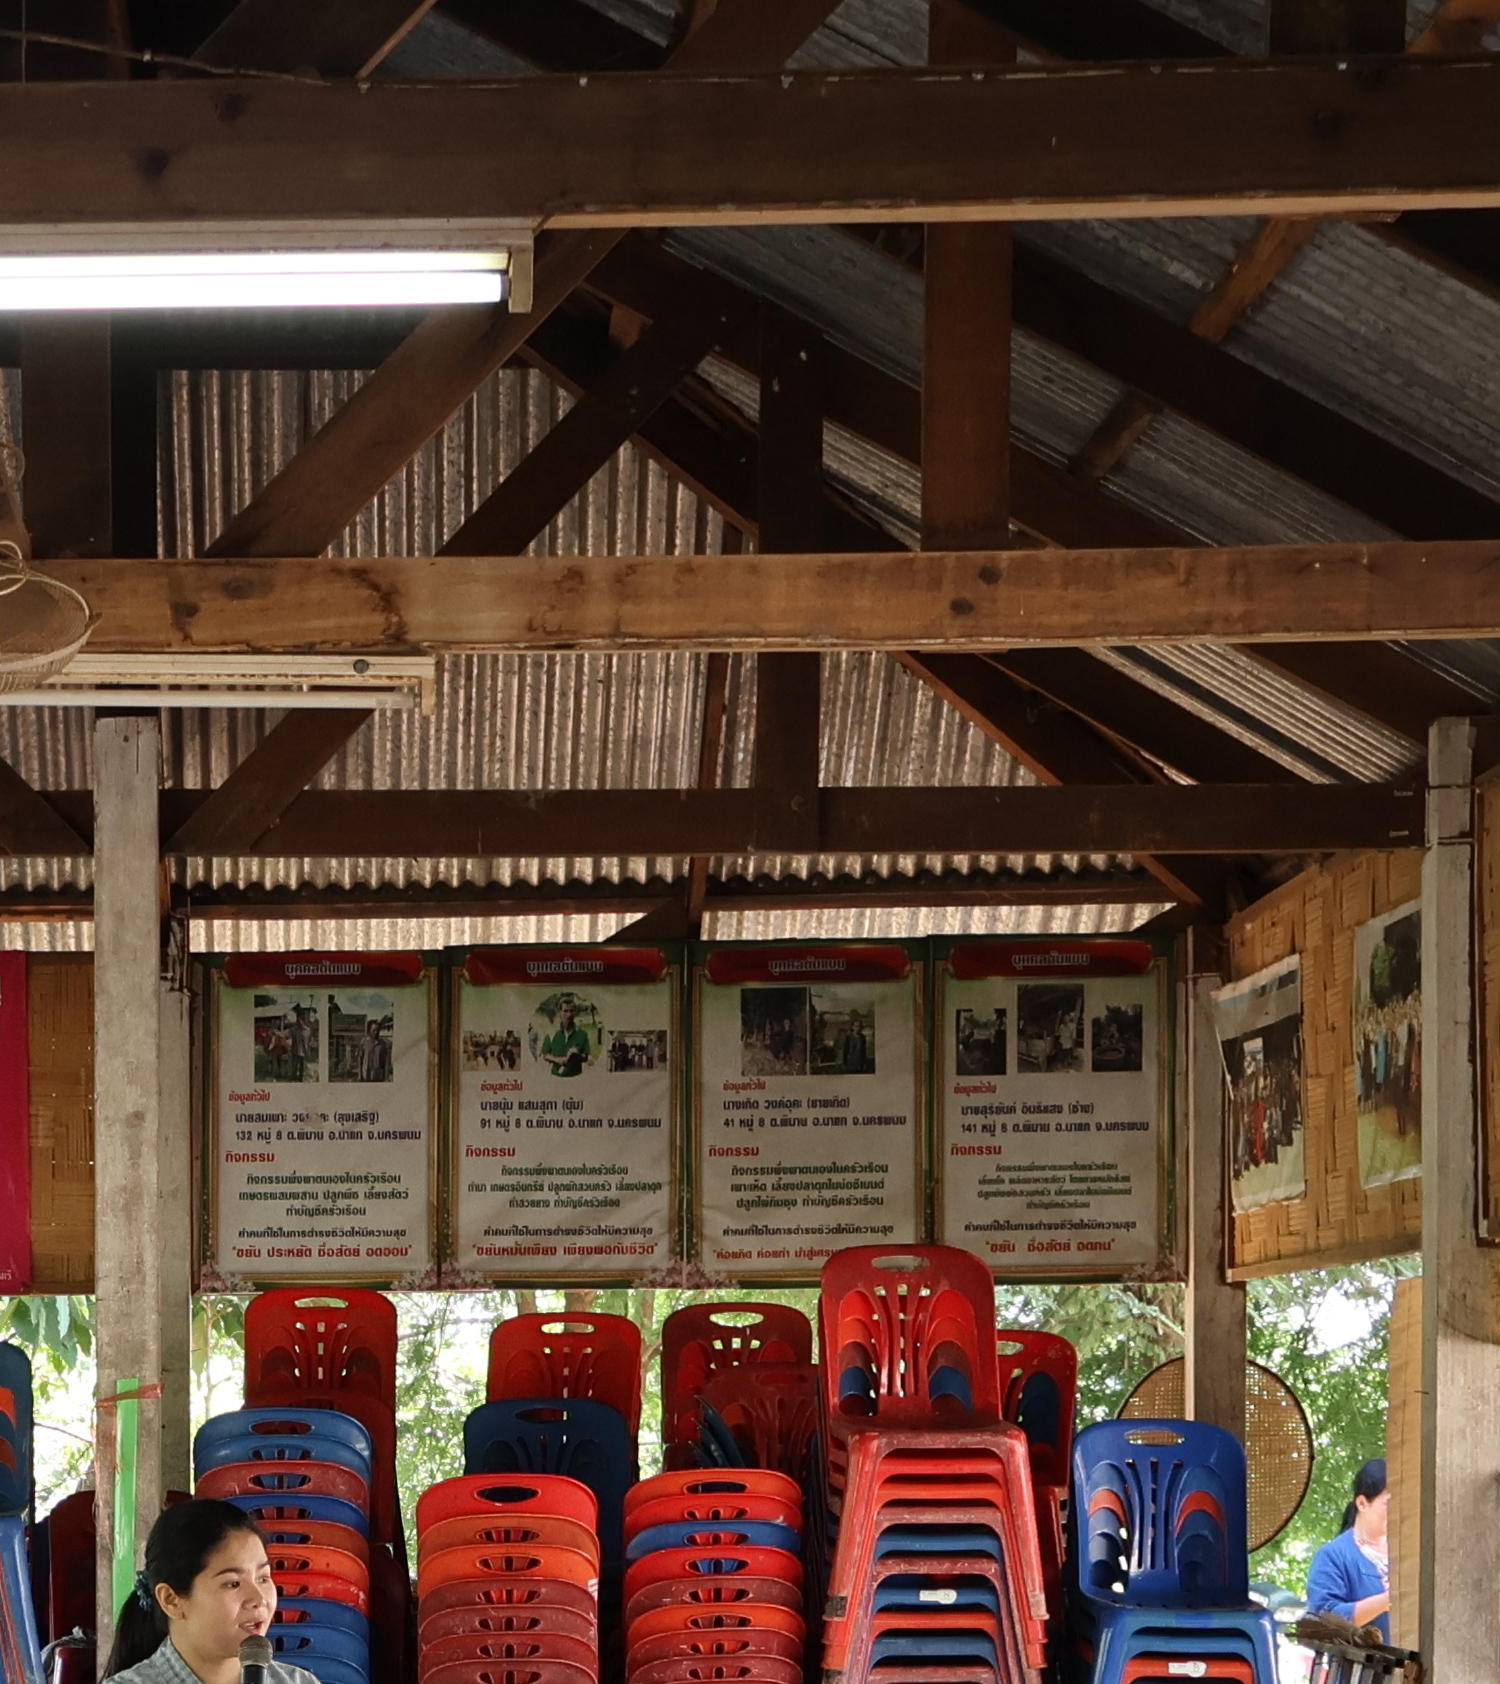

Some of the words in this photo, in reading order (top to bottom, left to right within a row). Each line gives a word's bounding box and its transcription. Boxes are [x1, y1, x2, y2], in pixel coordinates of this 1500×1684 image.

[480, 1118, 491, 1129] 91
[723, 1118, 735, 1128] 41
[961, 1123, 977, 1133] 141
[236, 1130, 252, 1141] 132
[276, 1131, 283, 1141] 8
[465, 1145, 516, 1158] กิจกรรม
[709, 1144, 760, 1158] กิจกรรม
[951, 1143, 1002, 1156] กิจกรรม
[225, 1150, 275, 1163] กิจกรรม
[267, 1245, 312, 1258] ประหยัด
